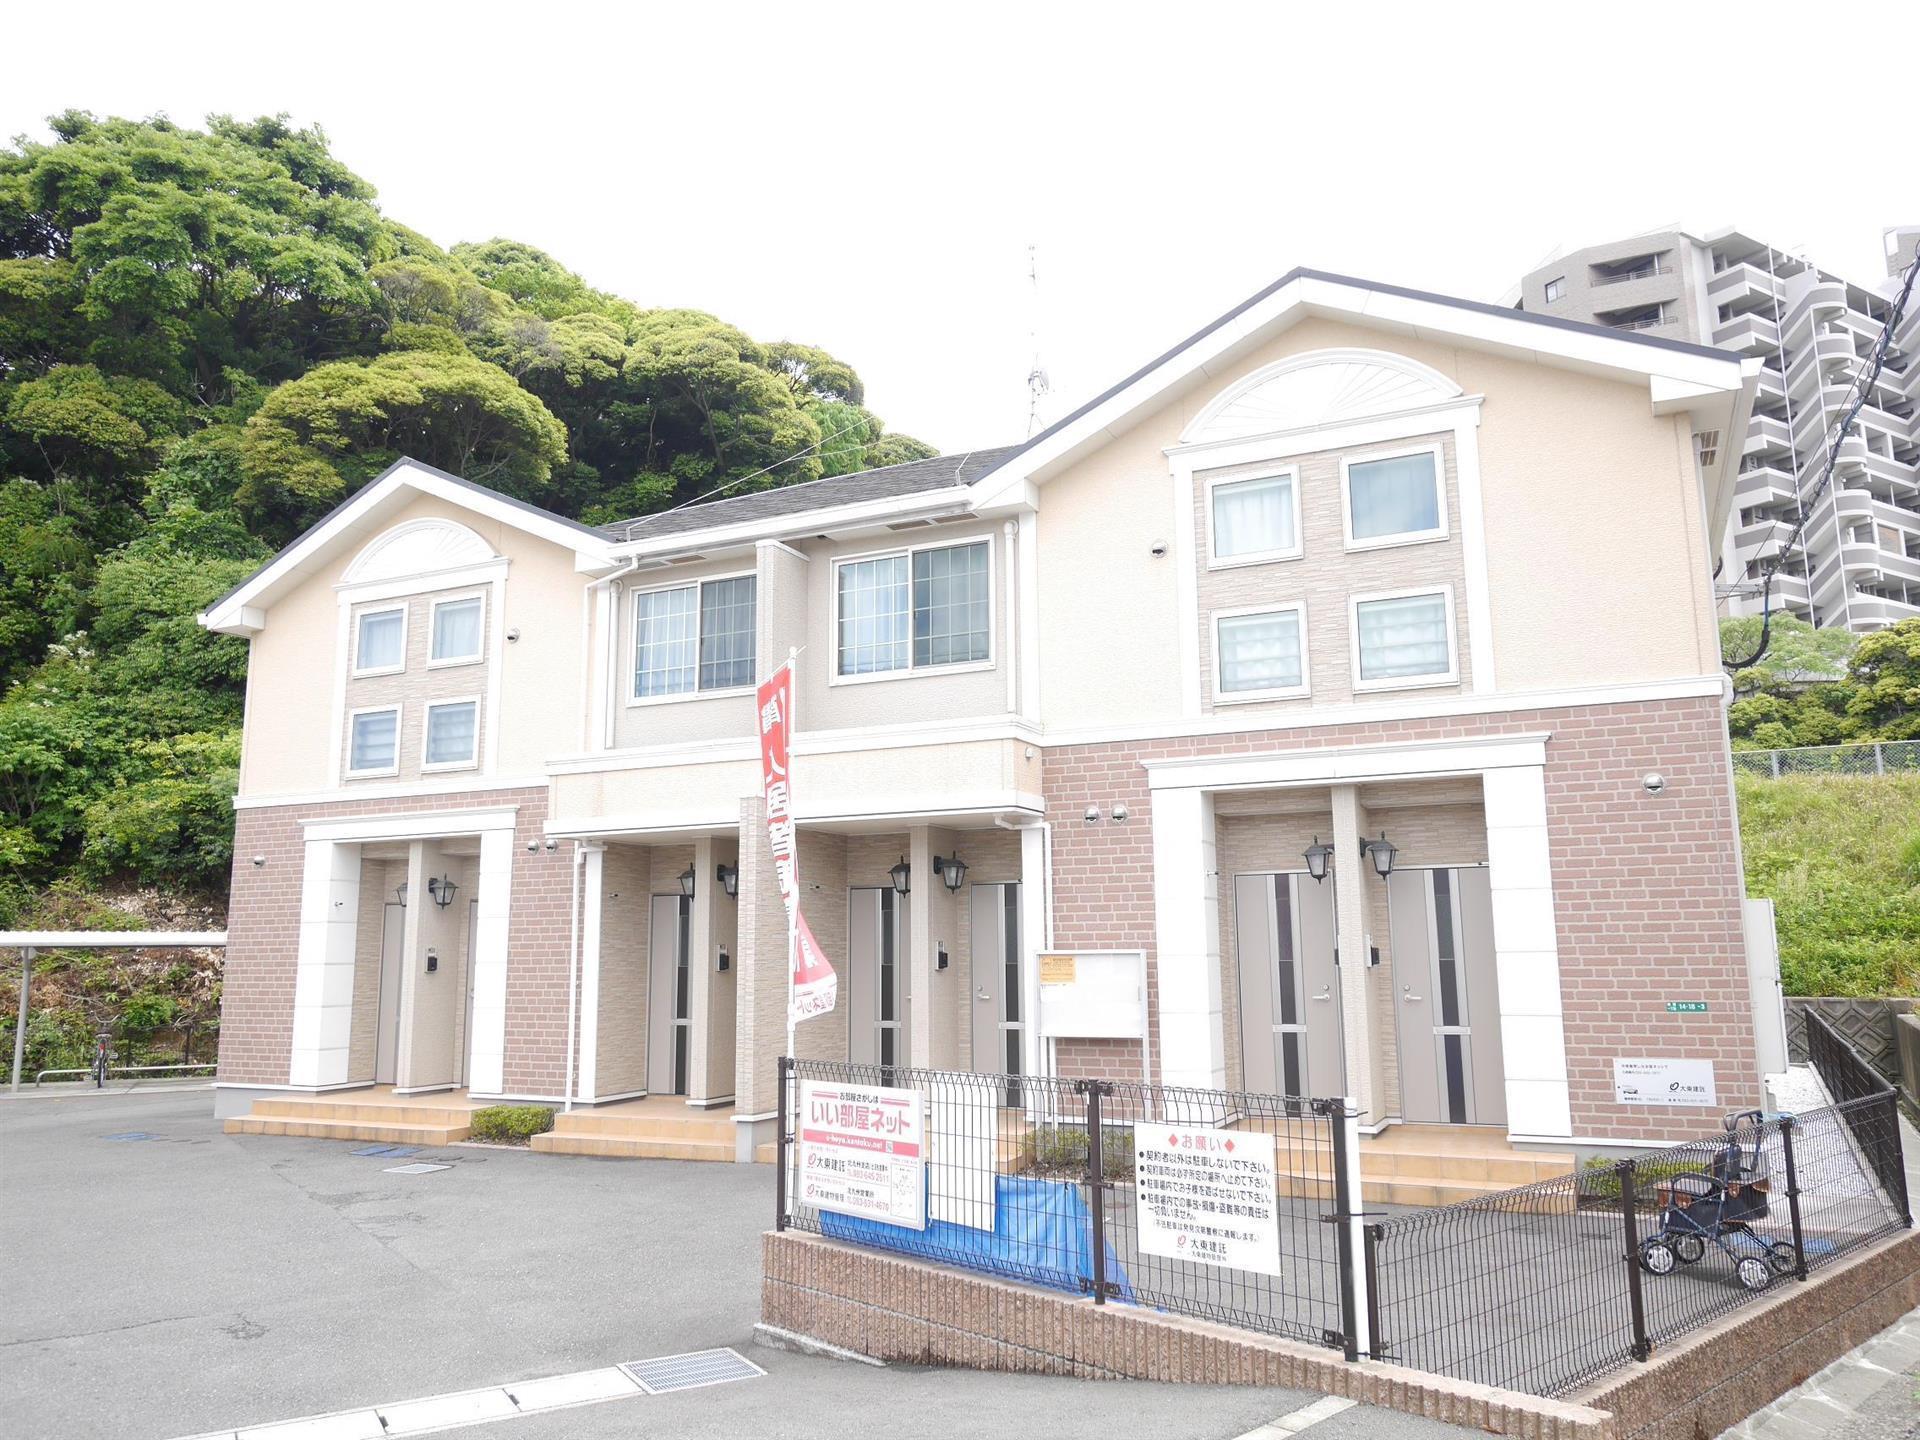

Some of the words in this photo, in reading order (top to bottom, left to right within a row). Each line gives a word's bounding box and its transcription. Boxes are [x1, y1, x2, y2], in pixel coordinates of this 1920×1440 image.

[811, 1100, 911, 1135] いい部屋ネット
[1181, 1134, 1222, 1152] お願い
[817, 1157, 845, 1172] 大東建託
[1190, 1239, 1227, 1254] 大東建託
